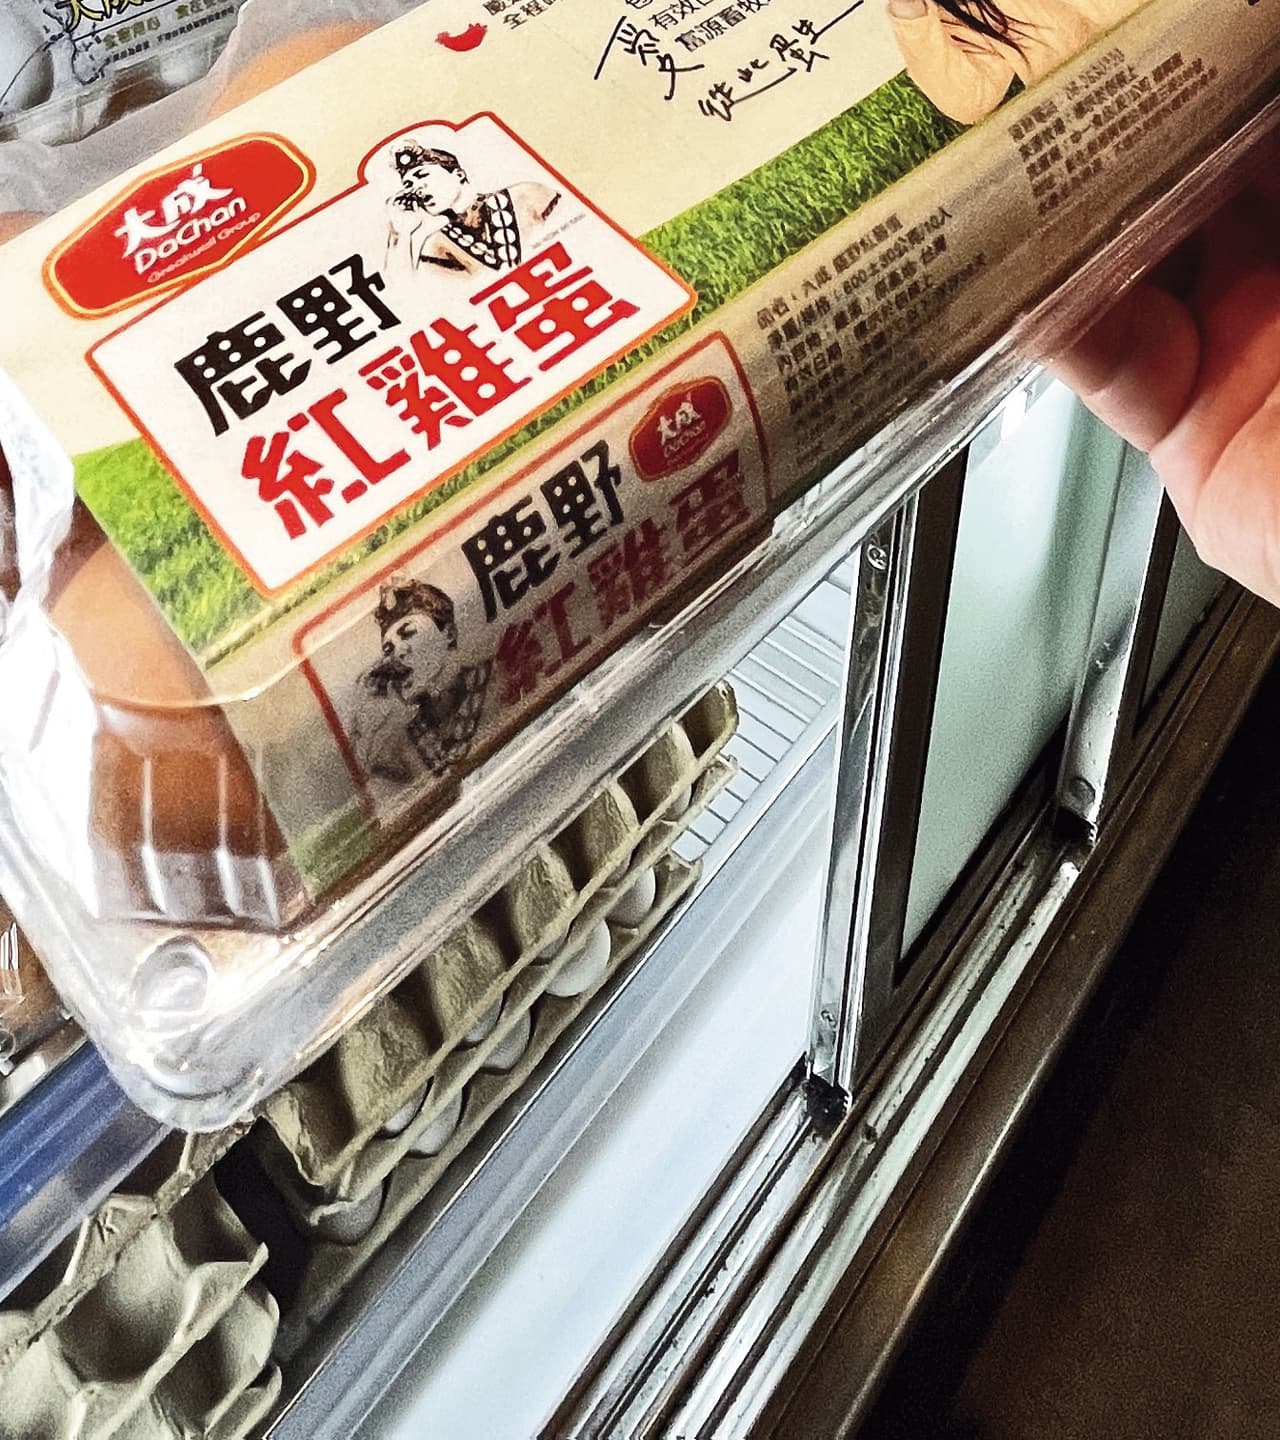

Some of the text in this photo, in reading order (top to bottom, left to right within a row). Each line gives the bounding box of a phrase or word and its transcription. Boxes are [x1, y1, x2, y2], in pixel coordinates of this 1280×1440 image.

[115, 163, 233, 254] 大成
[134, 194, 246, 274] DaChan
[173, 252, 402, 437] 鹿野
[240, 241, 642, 540] 紅雞蛋
[656, 393, 700, 444] 大成
[461, 439, 625, 624] 鹿野
[494, 449, 751, 708] 紅雞蛋
